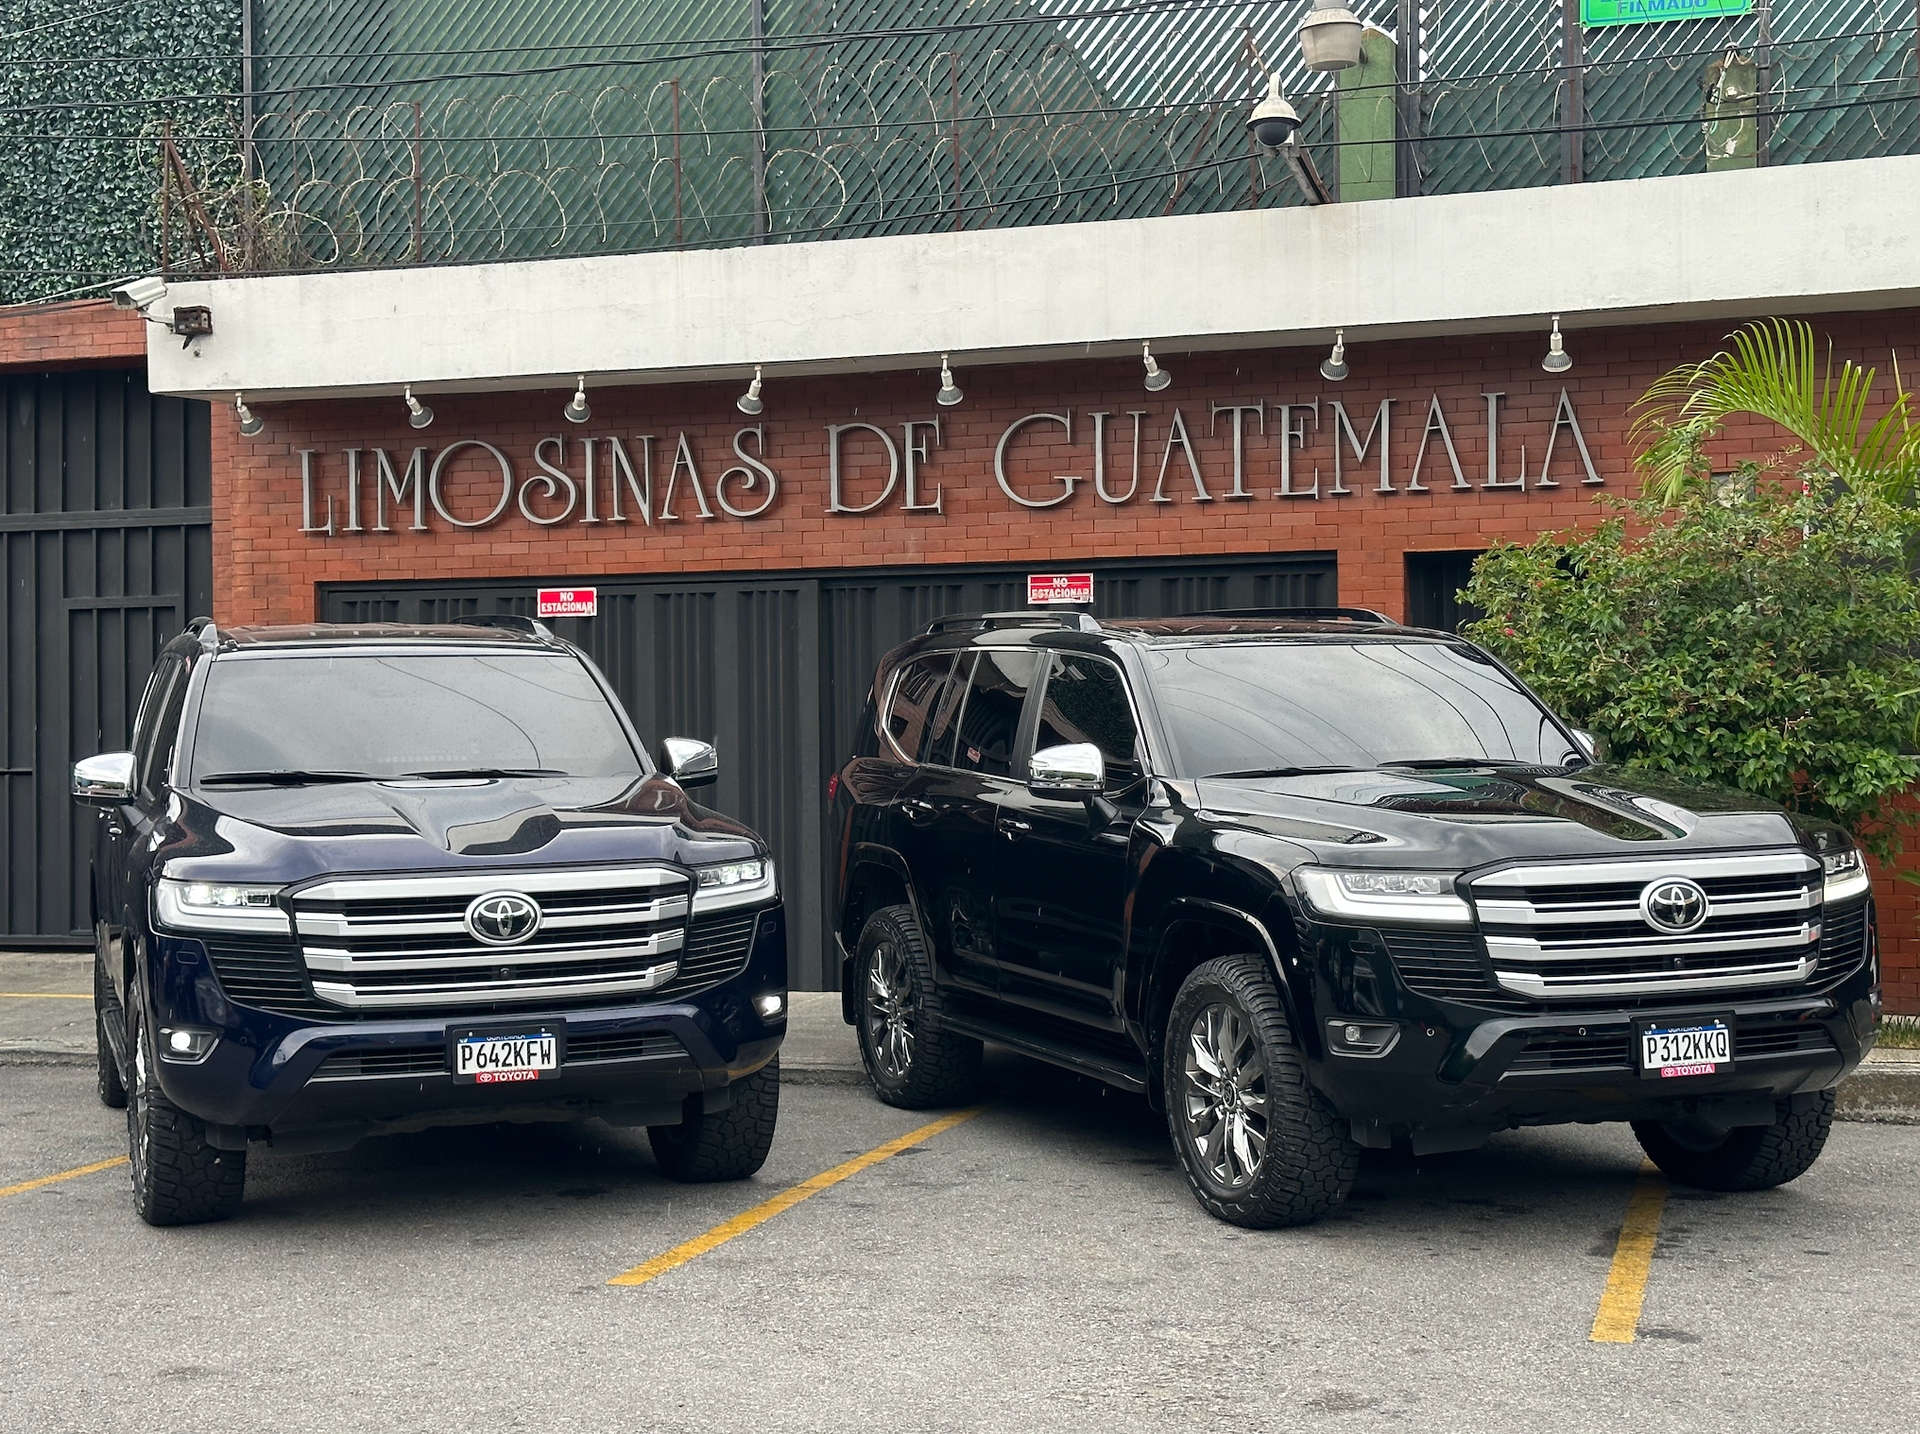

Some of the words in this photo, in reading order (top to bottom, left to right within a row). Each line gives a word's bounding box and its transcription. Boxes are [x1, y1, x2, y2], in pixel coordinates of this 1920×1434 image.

[1618, 0, 1708, 13] FILMADO
[298, 423, 779, 536] LIMOSINAS
[825, 413, 943, 514] DE
[993, 386, 1604, 507] GUATEMALA
[1053, 577, 1069, 588] NO
[560, 592, 574, 602] NO
[1031, 588, 1090, 600] ESTACIONAR
[541, 602, 593, 613] ESTACIONAR
[1646, 1032, 1727, 1064] P312KKQ
[461, 1039, 551, 1070] P642KFW
[1675, 1064, 1713, 1076] TOYOTA
[493, 1071, 535, 1082] TOYOTA
